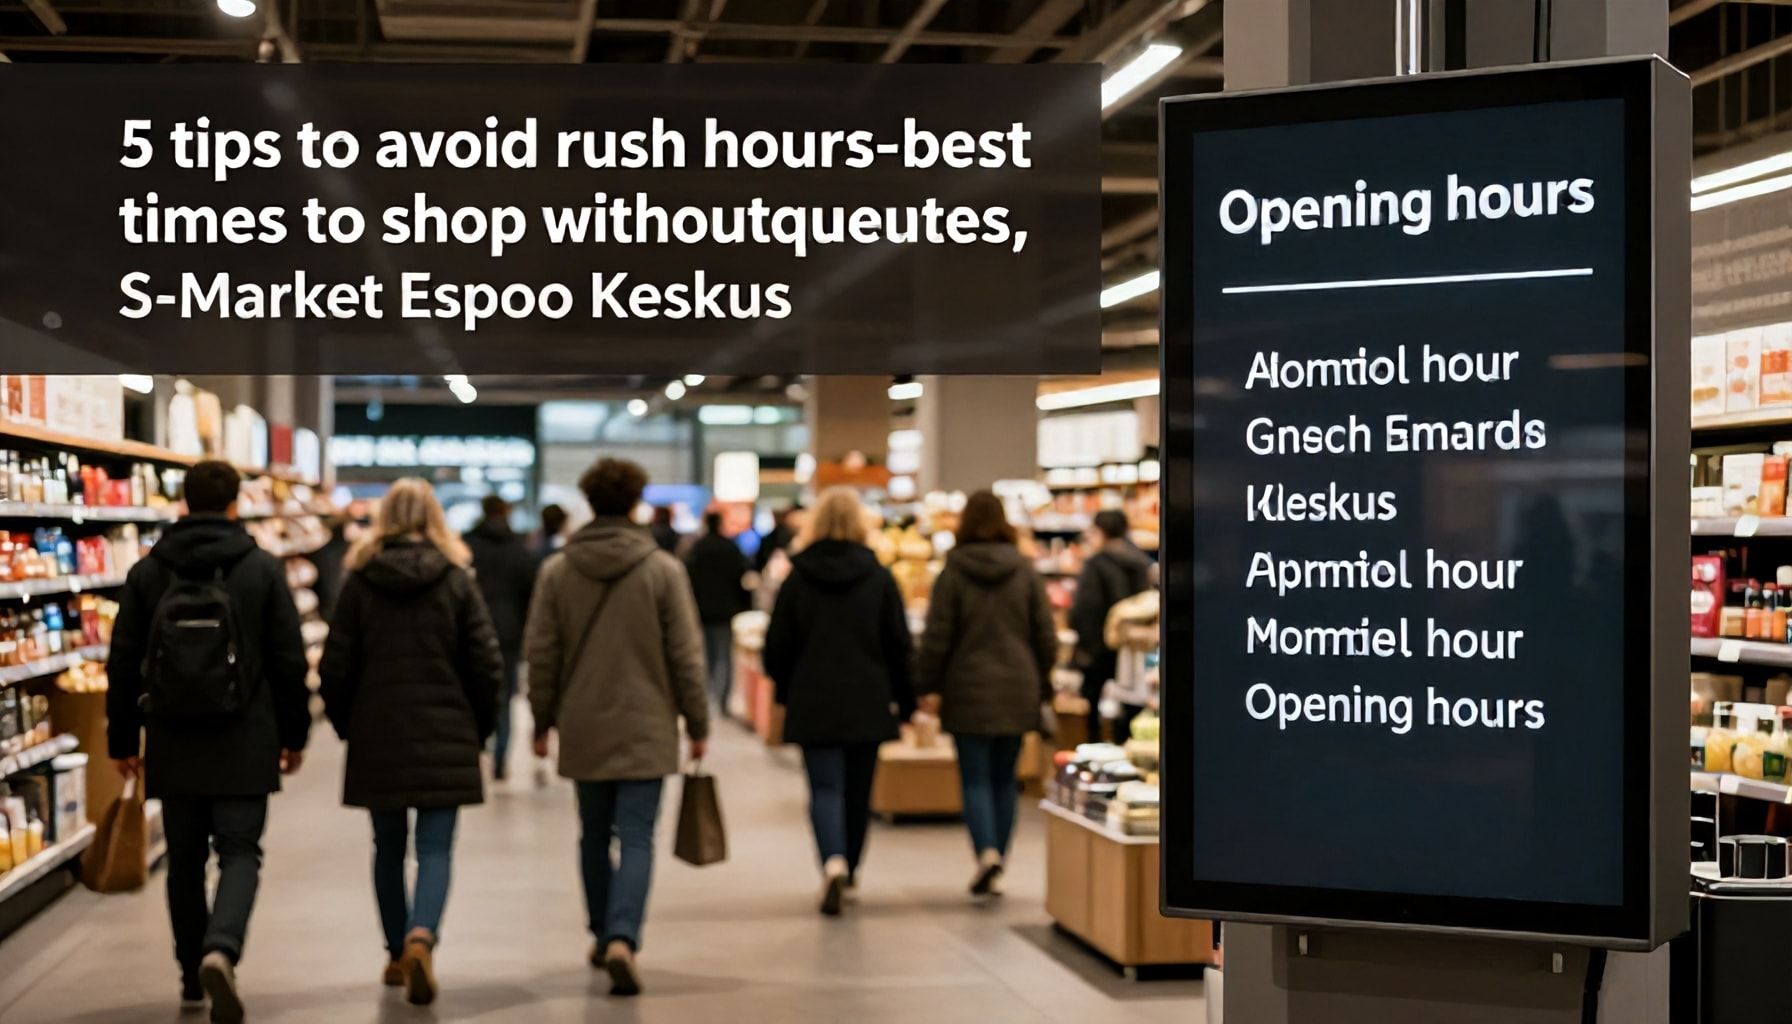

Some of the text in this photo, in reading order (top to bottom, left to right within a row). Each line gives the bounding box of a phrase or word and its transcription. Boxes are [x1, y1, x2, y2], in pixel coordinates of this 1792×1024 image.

[1219, 173, 1595, 245] Opening hours
[1422, 343, 1520, 383] hour
[1426, 548, 1524, 590] hour
[1427, 617, 1524, 660] hour
[1245, 682, 1546, 735] Opening hours
